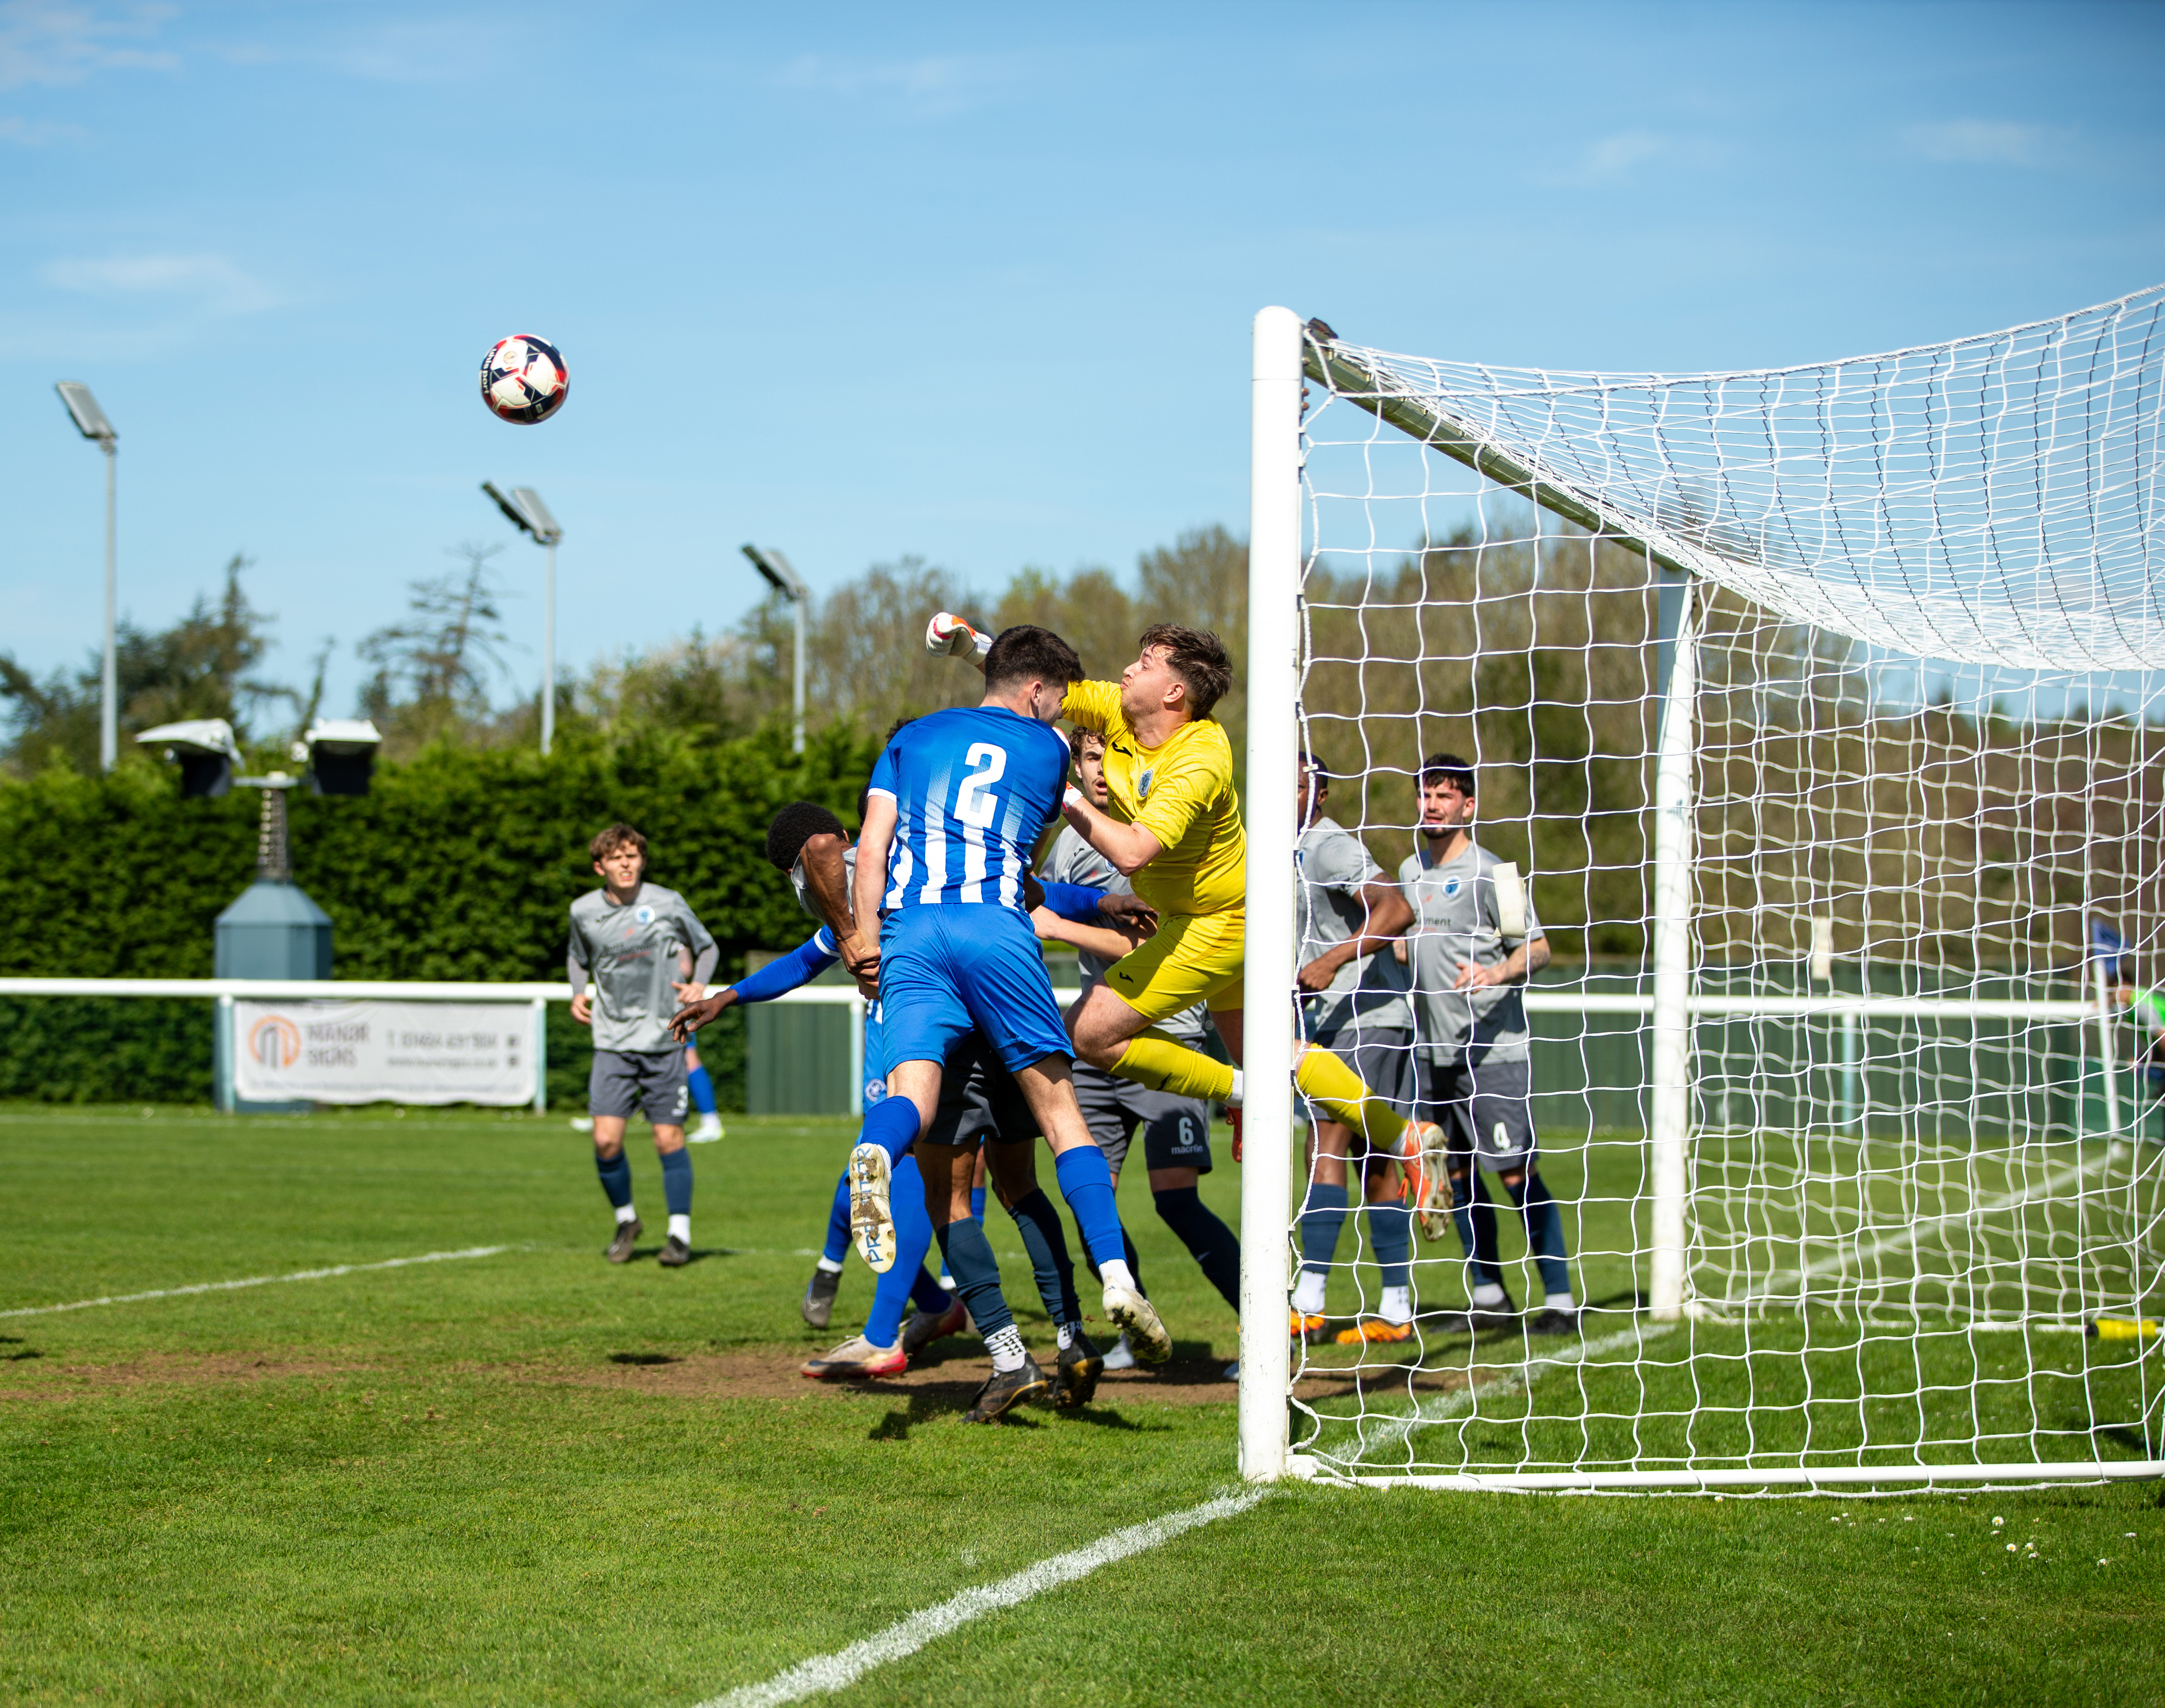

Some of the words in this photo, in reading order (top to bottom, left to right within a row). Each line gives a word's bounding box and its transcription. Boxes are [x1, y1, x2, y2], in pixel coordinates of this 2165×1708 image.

[482, 348, 497, 394] uhlsport
[954, 742, 1007, 829] 2
[677, 1085, 688, 1110] 3
[1179, 1116, 1194, 1146] 6
[1493, 1121, 1511, 1151] 4
[1171, 1144, 1203, 1154] macron
